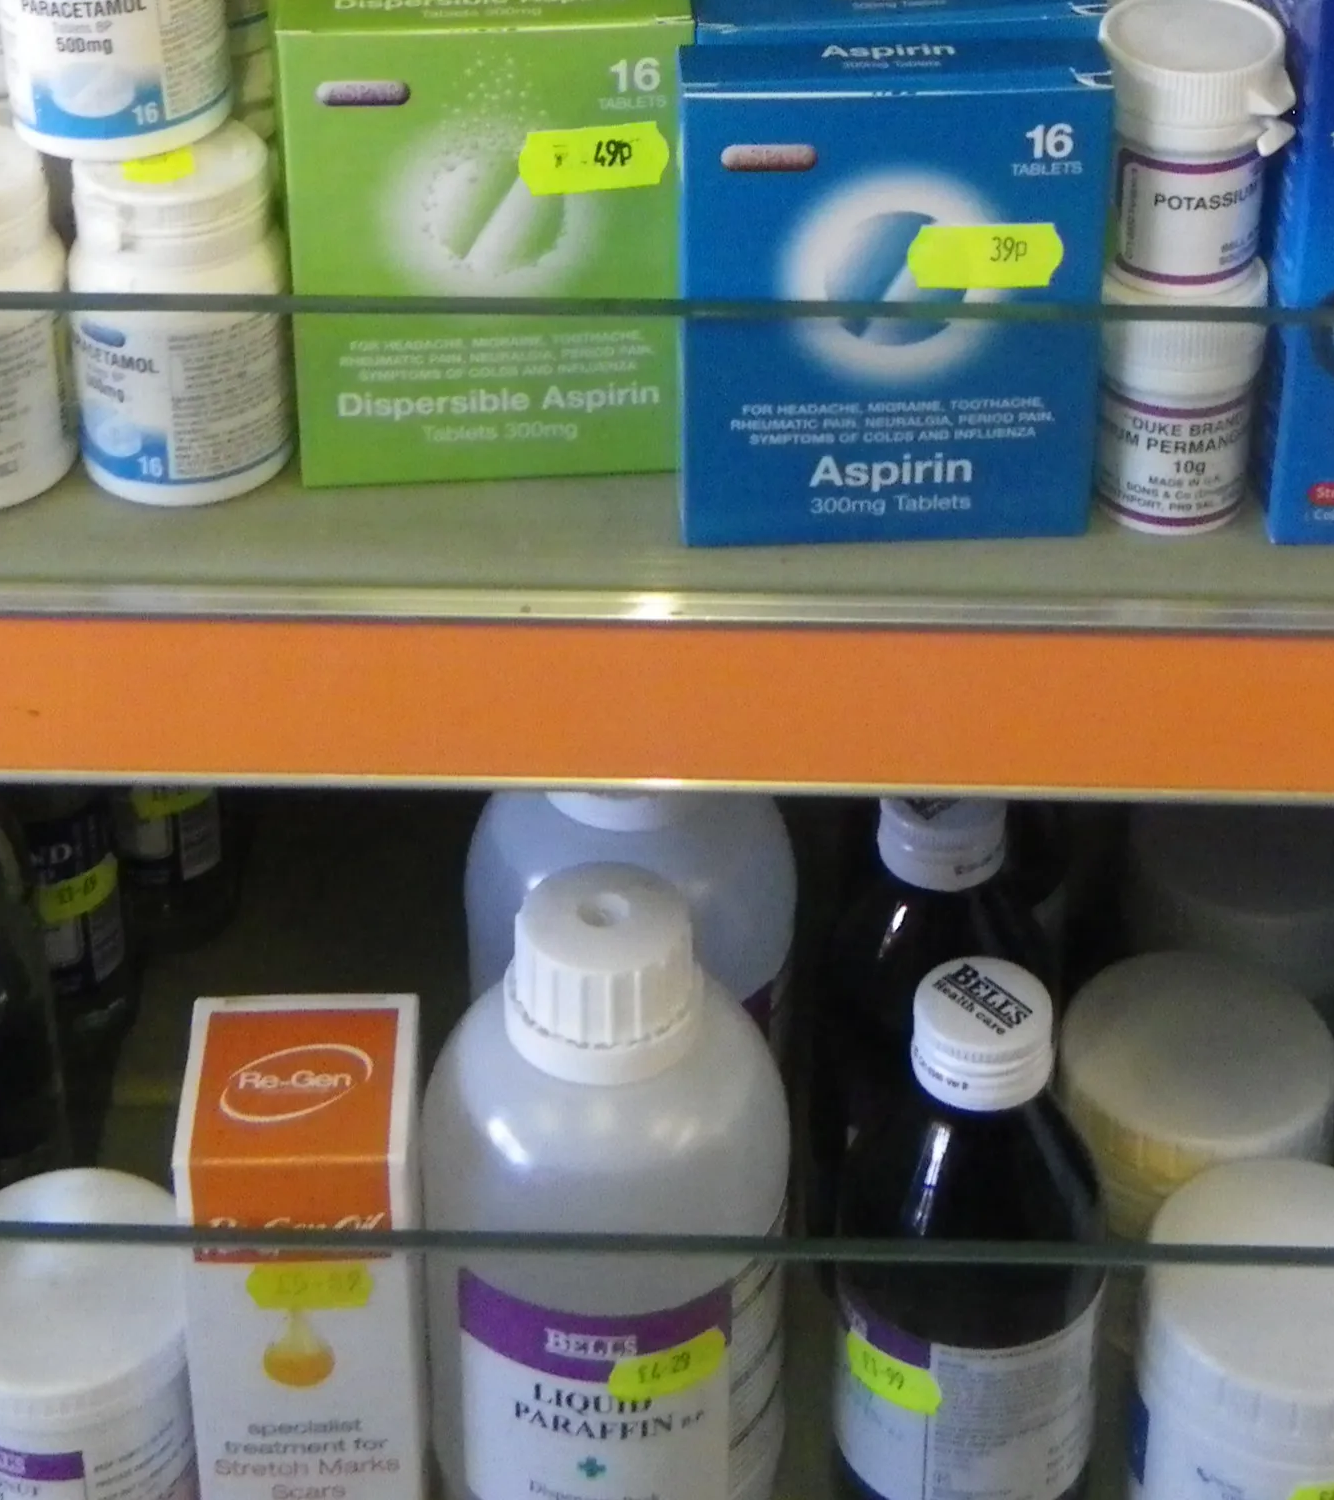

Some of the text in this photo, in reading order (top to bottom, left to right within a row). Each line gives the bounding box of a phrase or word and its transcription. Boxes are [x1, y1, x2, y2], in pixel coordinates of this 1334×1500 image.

[55, 35, 114, 56] 500mg
[821, 42, 956, 61] Aspirin
[609, 57, 660, 94] 16
[131, 101, 160, 126] 16
[1025, 123, 1074, 160] 16
[1010, 161, 1083, 177] TABLETS
[989, 236, 1028, 264] 39p
[337, 381, 660, 421] Dispersible Aspirin
[742, 403, 774, 415] FOR
[423, 420, 579, 443] Tablets 300mg
[838, 427, 1036, 444] OF COLDS INFLUENZA
[809, 454, 973, 492] Aspirin
[1173, 459, 1206, 476] 10g
[811, 494, 972, 515] 300mg Tablets
[945, 961, 1033, 1030] BELLS
[932, 978, 1007, 1037] Health care
[237, 1069, 353, 1091] Re-Gen
[544, 1327, 638, 1363] BELLS
[533, 1382, 654, 1415] LIQUID
[247, 1418, 362, 1436] specialist
[514, 1400, 673, 1440] PARAFFIN
[225, 1437, 387, 1454] treatment for
[214, 1456, 401, 1476] Stretch Marks
